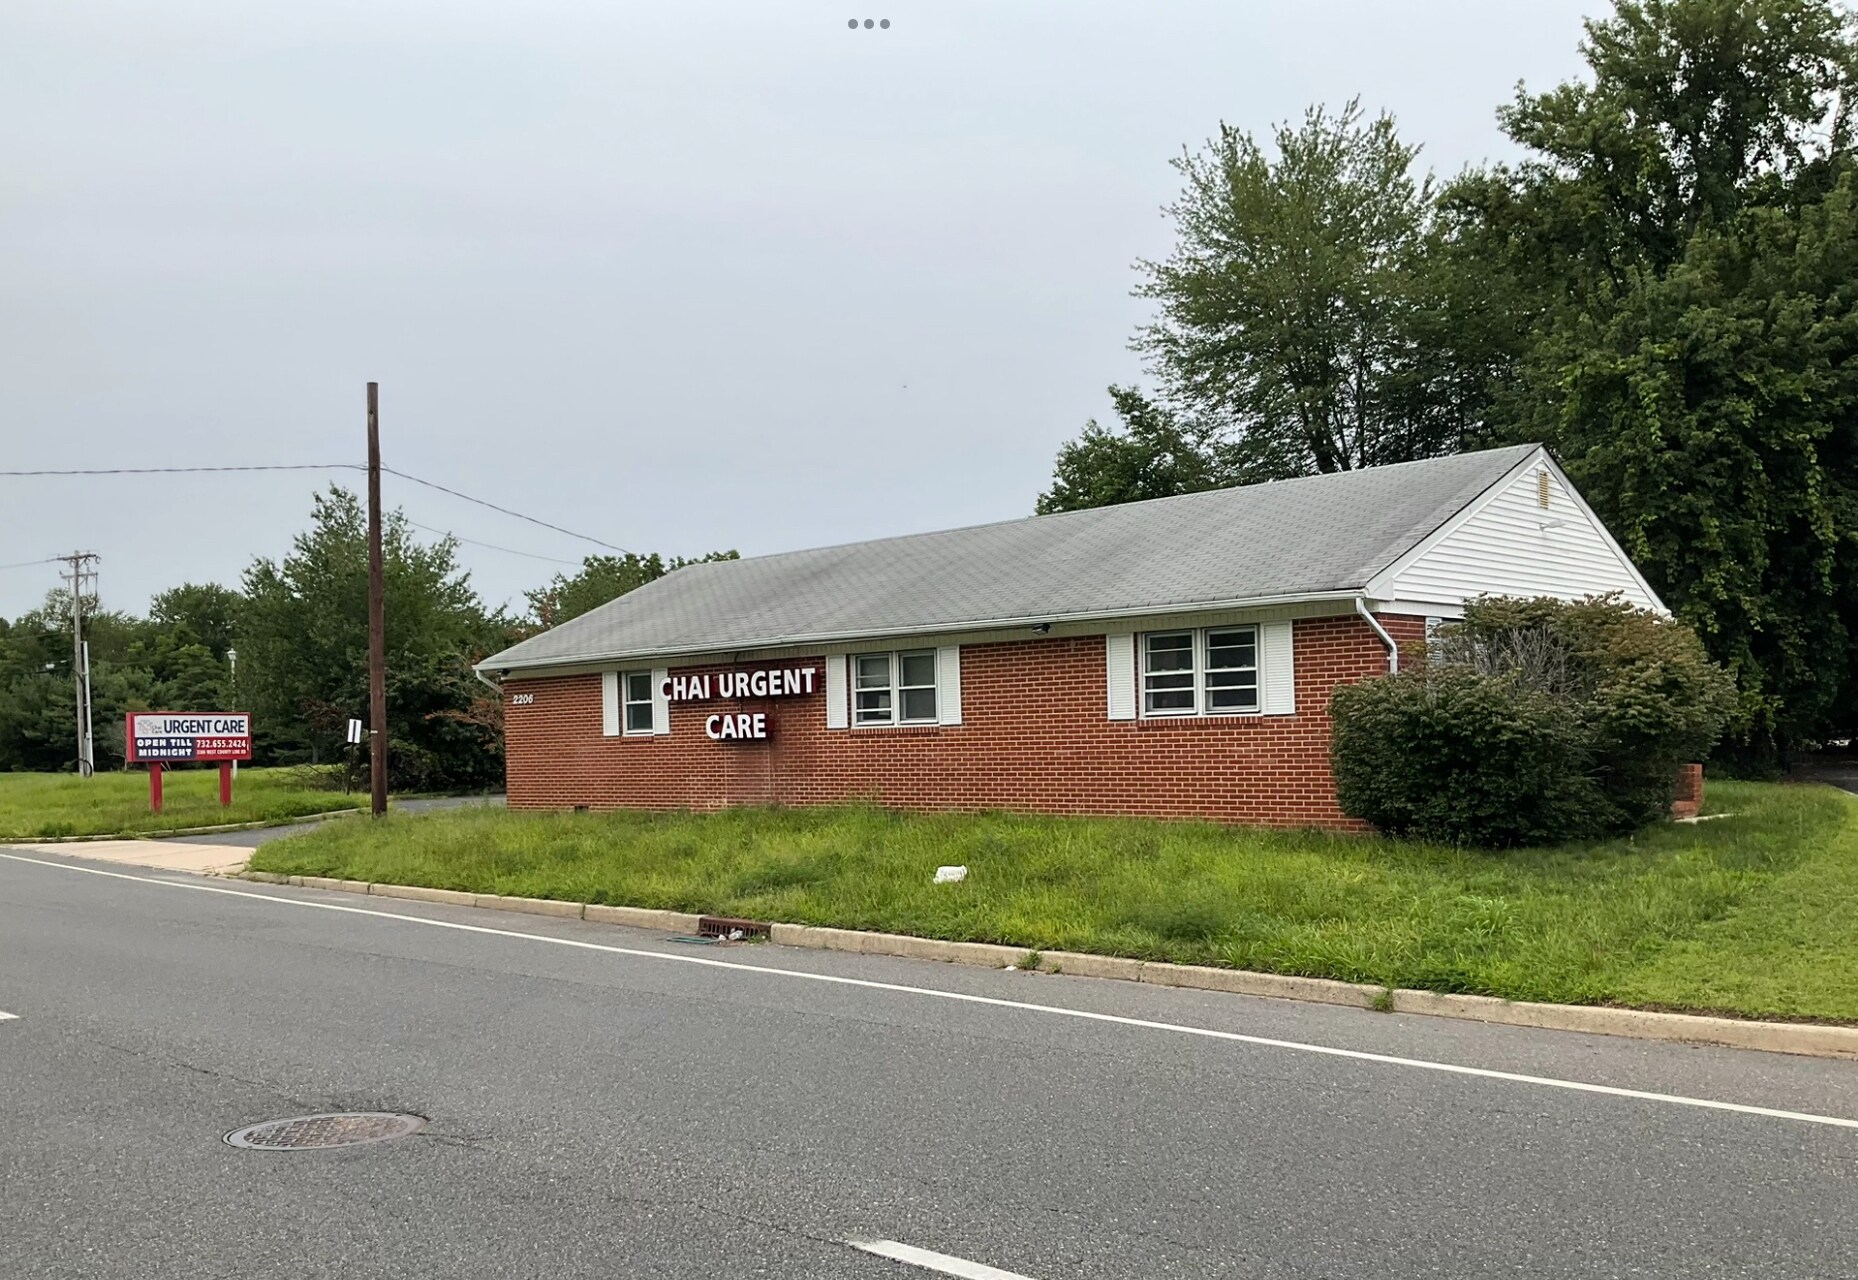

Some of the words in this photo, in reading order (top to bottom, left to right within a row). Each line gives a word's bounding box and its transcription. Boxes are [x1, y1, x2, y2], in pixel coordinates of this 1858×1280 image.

[659, 676, 710, 701] CHAI
[718, 668, 815, 698] URGENT
[512, 694, 534, 705] 2206
[163, 720, 212, 733] URGENT
[214, 720, 245, 733] CARE
[705, 714, 767, 739] CARE
[137, 739, 167, 747] OPEN
[170, 739, 192, 747] TILL
[196, 740, 246, 748] 732.655.2424
